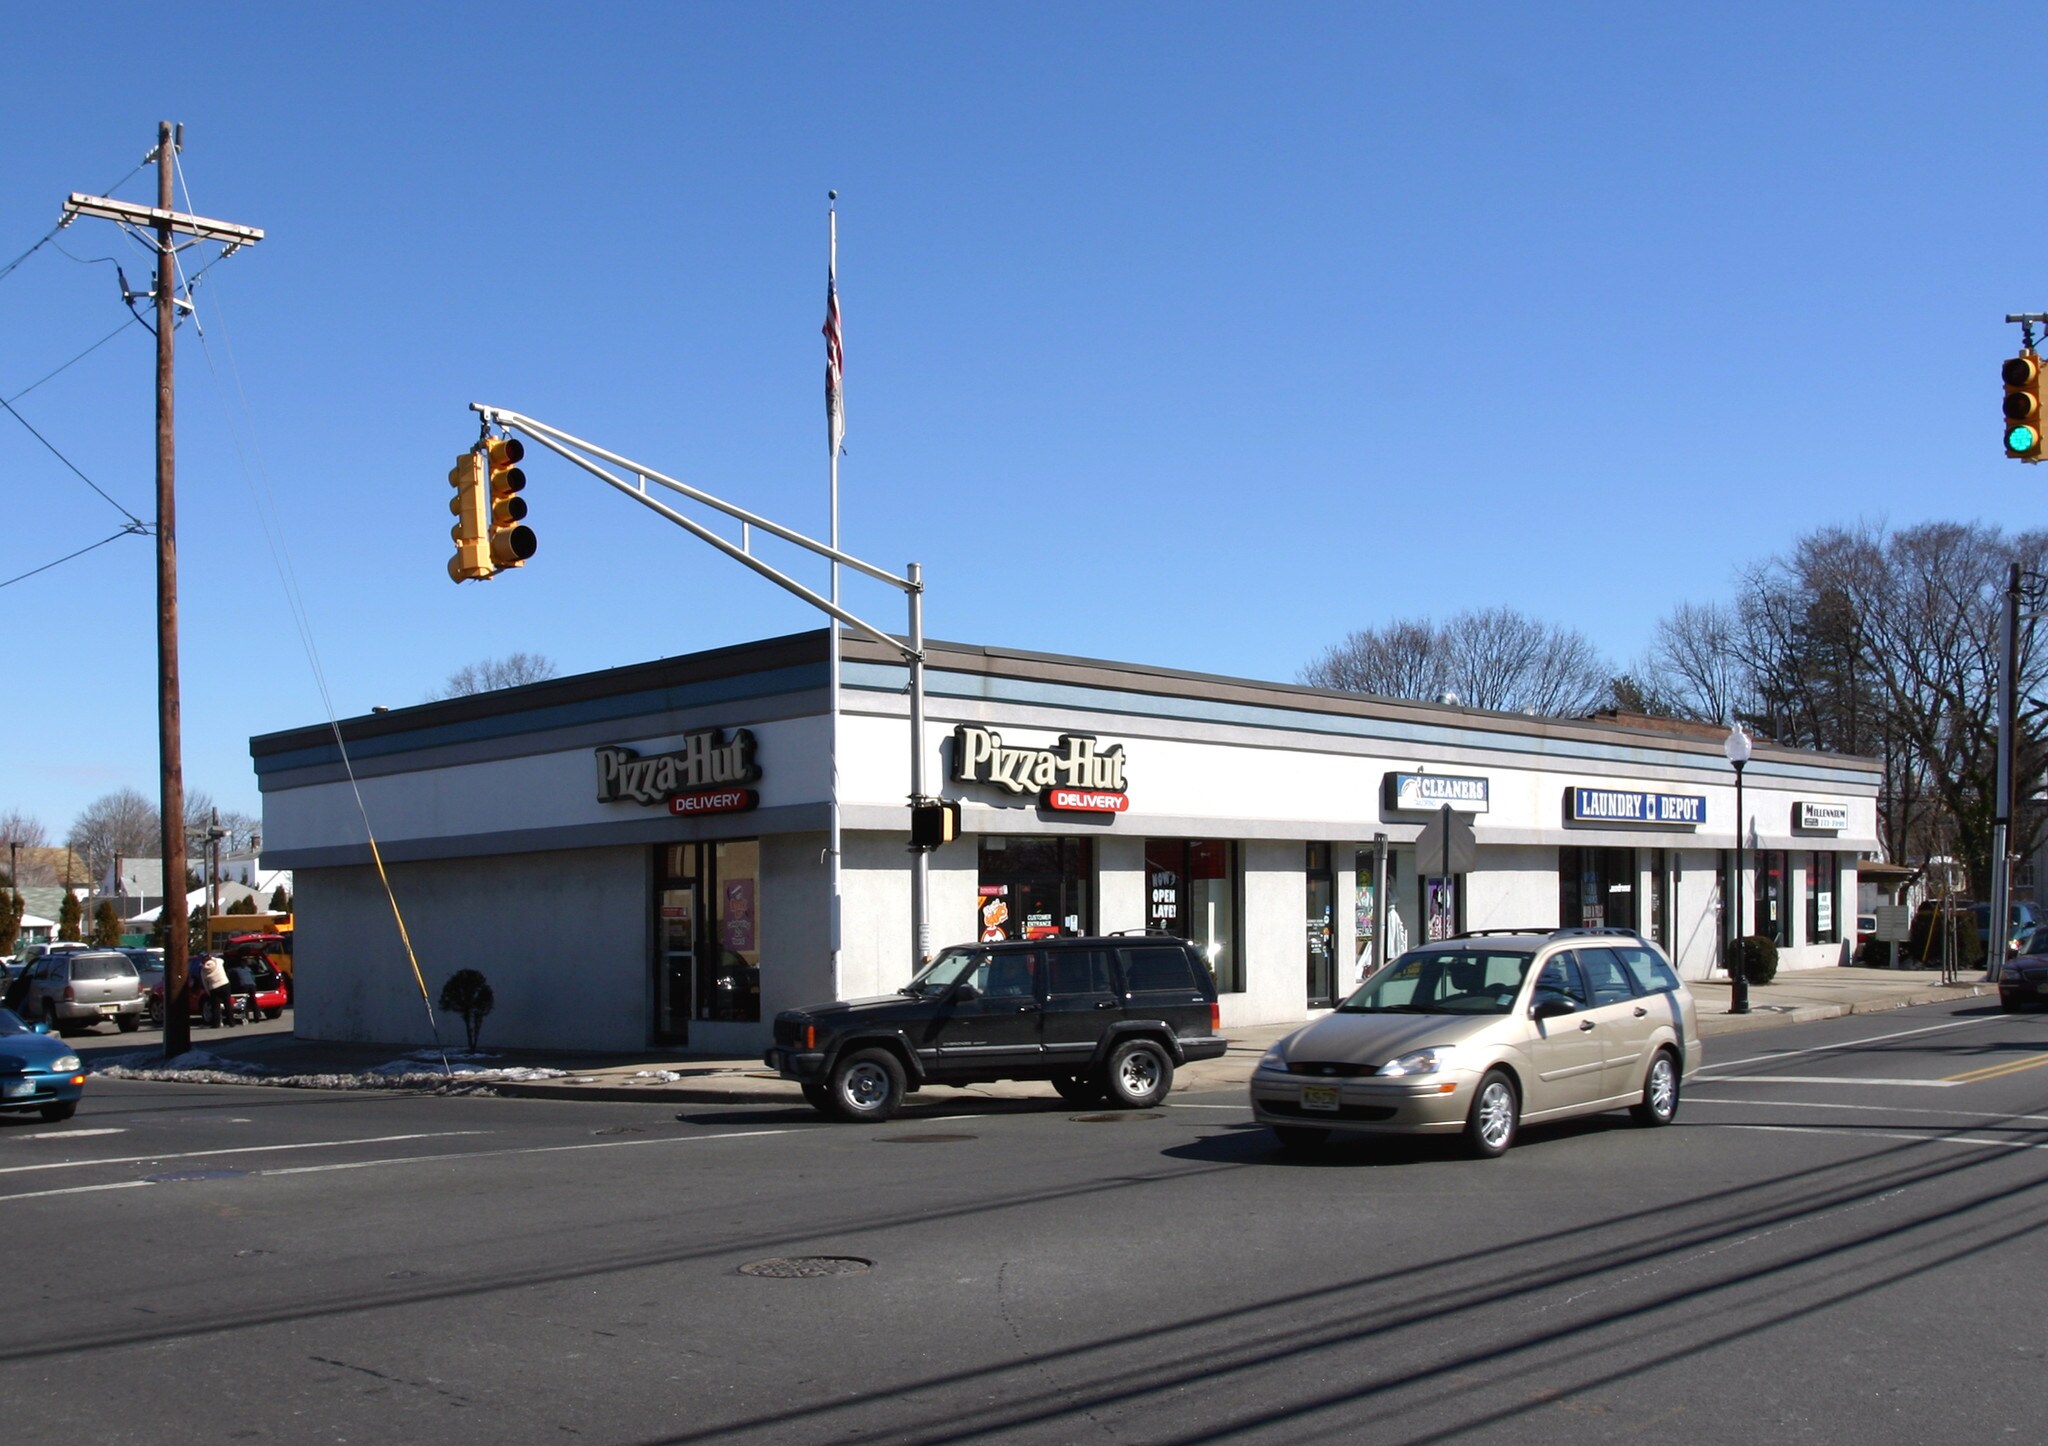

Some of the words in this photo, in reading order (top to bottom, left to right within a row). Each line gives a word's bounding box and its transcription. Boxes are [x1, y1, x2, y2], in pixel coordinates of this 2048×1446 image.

[597, 748, 678, 800] Pizza
[684, 731, 749, 786] Hut
[960, 727, 1057, 794] Pizza
[1065, 736, 1126, 790] Hut
[1421, 778, 1484, 800] CLEANERS
[675, 792, 741, 812] DELIVERY
[1057, 792, 1123, 809] DELIVERY
[1582, 791, 1642, 817] LAUNDRY
[1661, 796, 1699, 820] DEPOT
[1152, 888, 1175, 903] OPEN
[1152, 904, 1177, 918] LATE!
